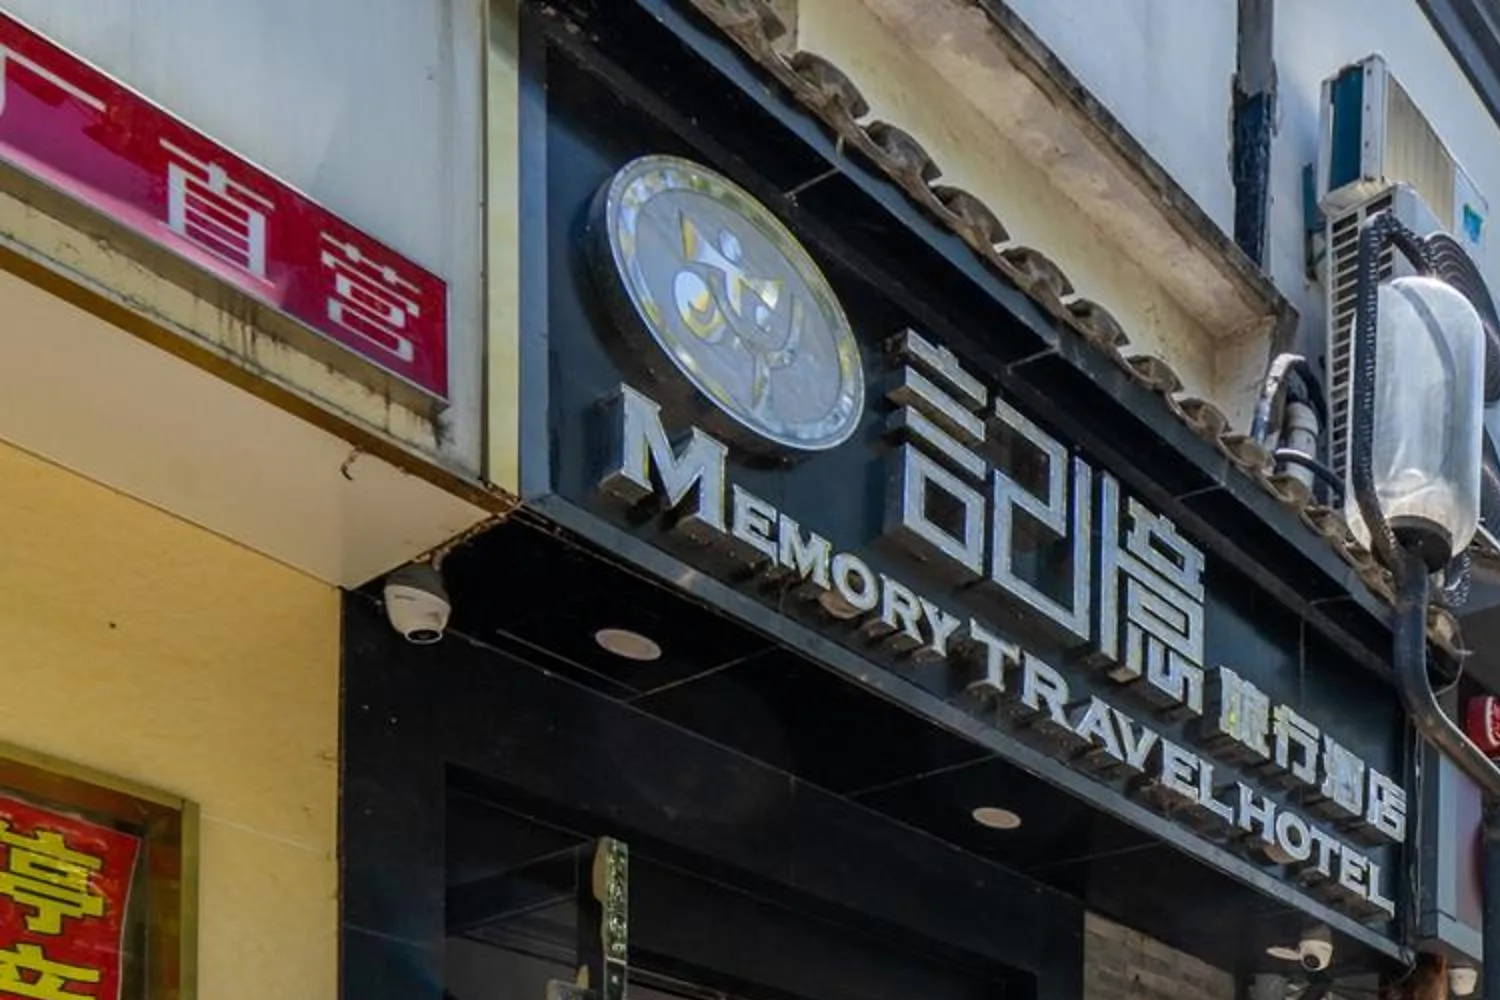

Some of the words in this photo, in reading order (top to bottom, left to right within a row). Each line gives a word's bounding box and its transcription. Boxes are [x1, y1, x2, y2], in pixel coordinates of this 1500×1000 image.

[620, 382, 961, 658] MEMORY
[969, 618, 1234, 825] TRAVEL
[1236, 781, 1396, 921] HOTEL
